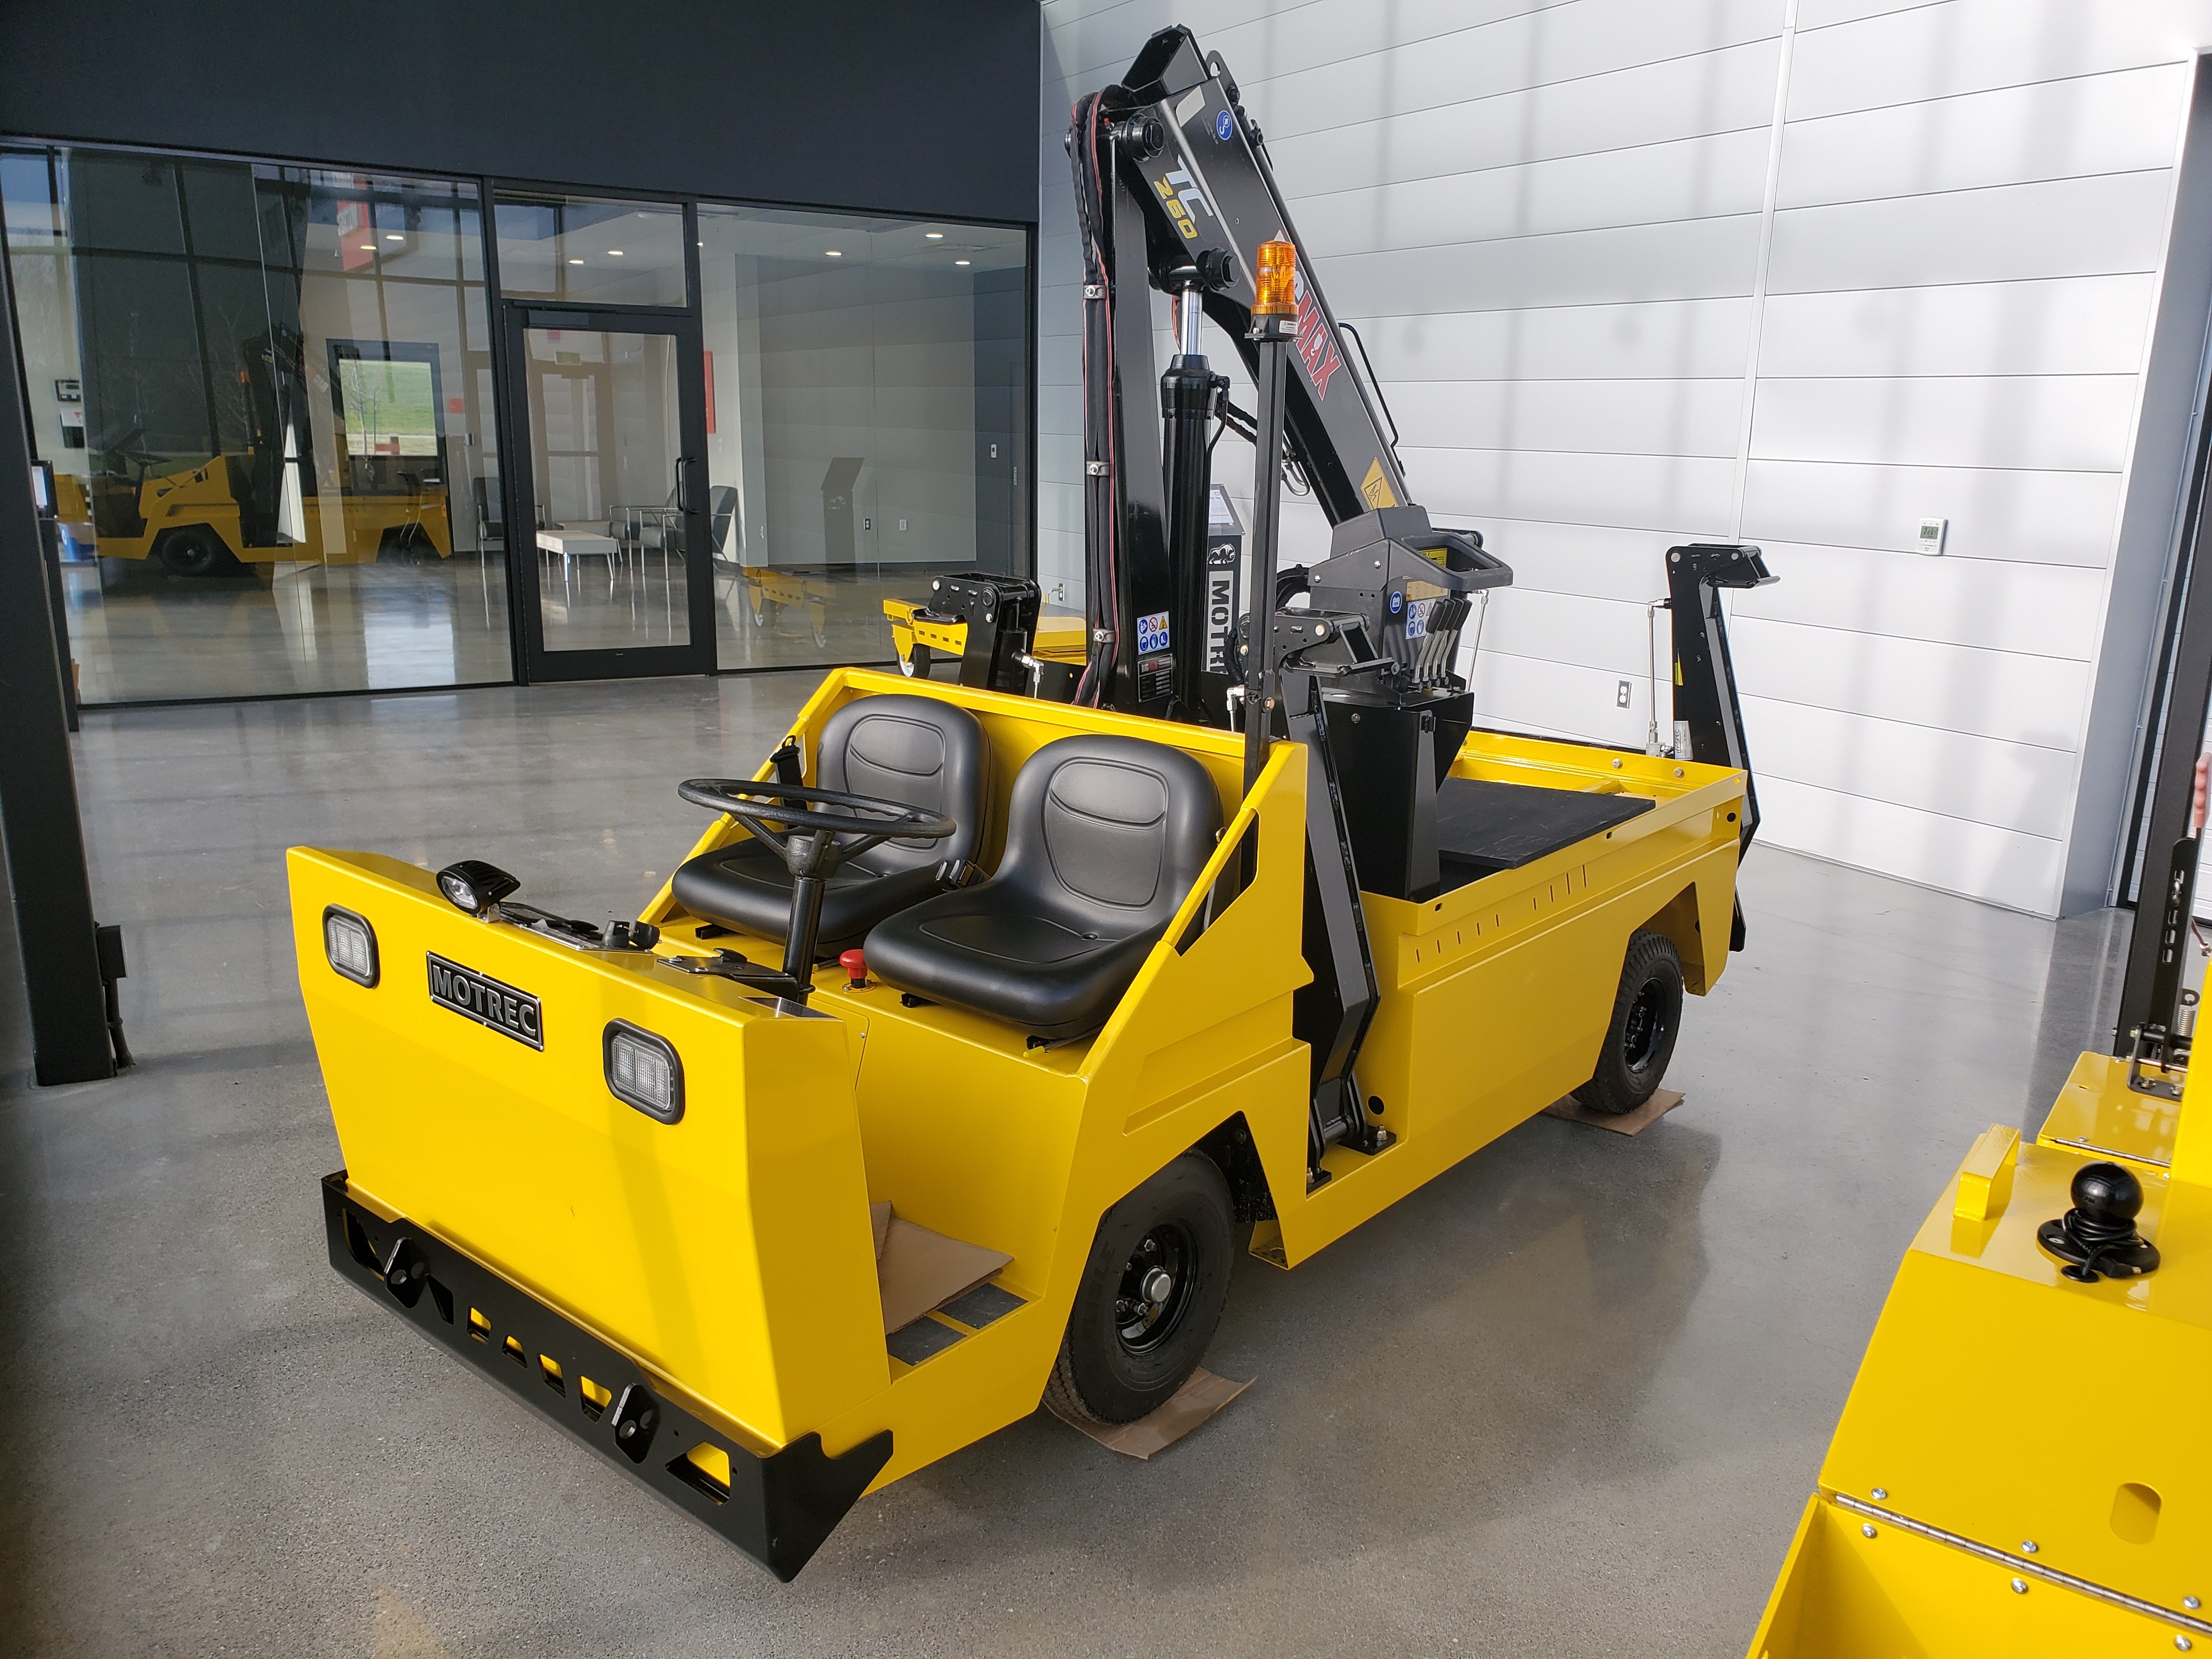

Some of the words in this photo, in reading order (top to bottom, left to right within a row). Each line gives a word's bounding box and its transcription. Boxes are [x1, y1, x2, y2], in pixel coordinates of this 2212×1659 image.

[1154, 176, 1197, 239] 260
[1165, 154, 1214, 224] TC
[433, 964, 536, 1036] MOTREC
